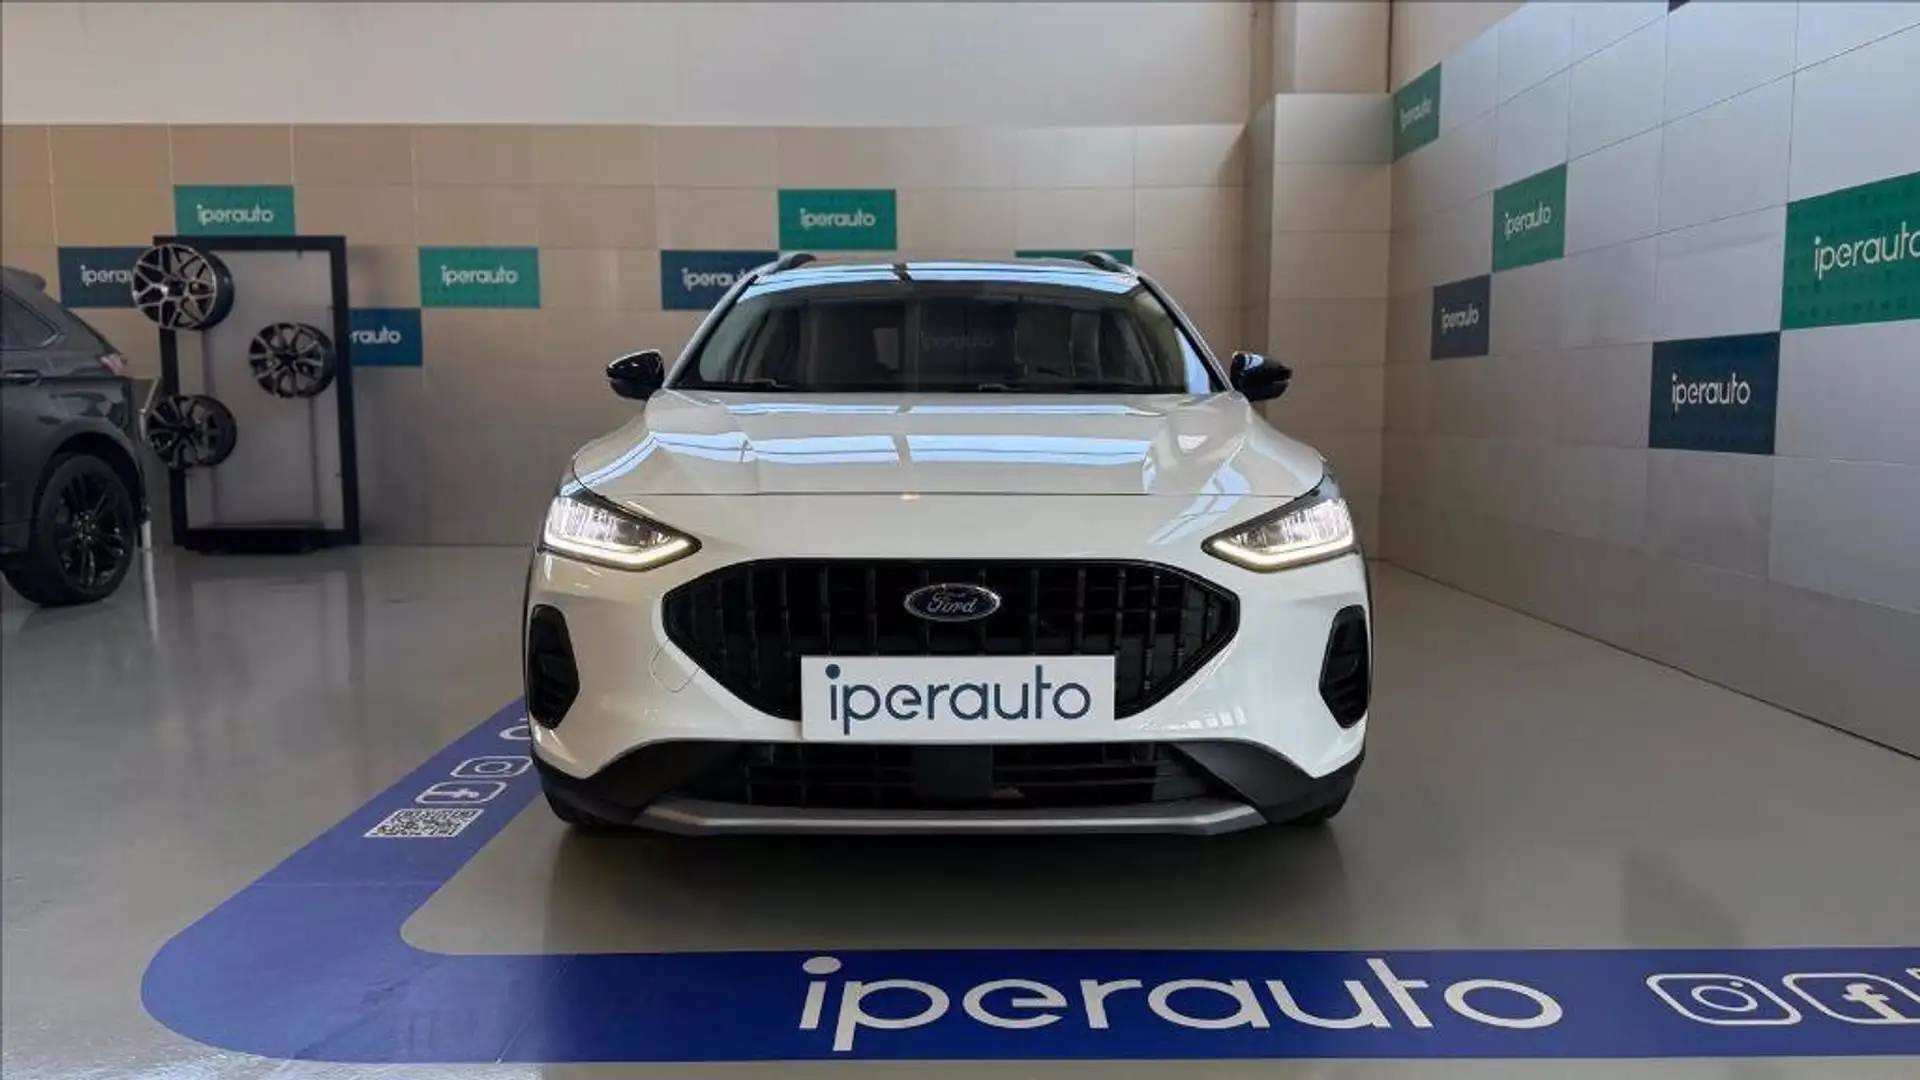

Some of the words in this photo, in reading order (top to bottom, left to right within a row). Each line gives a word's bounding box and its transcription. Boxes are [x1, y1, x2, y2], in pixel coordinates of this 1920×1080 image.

[196, 203, 273, 226] iperauto
[800, 207, 876, 231] iperauto
[1504, 201, 1551, 240] iperauto
[440, 265, 518, 286] iperauto
[349, 325, 401, 344] rauto
[1672, 372, 1750, 413] iperauto
[927, 591, 977, 613] Ford
[825, 663, 1091, 736] iperauto
[799, 956, 1562, 1052] iperauto
